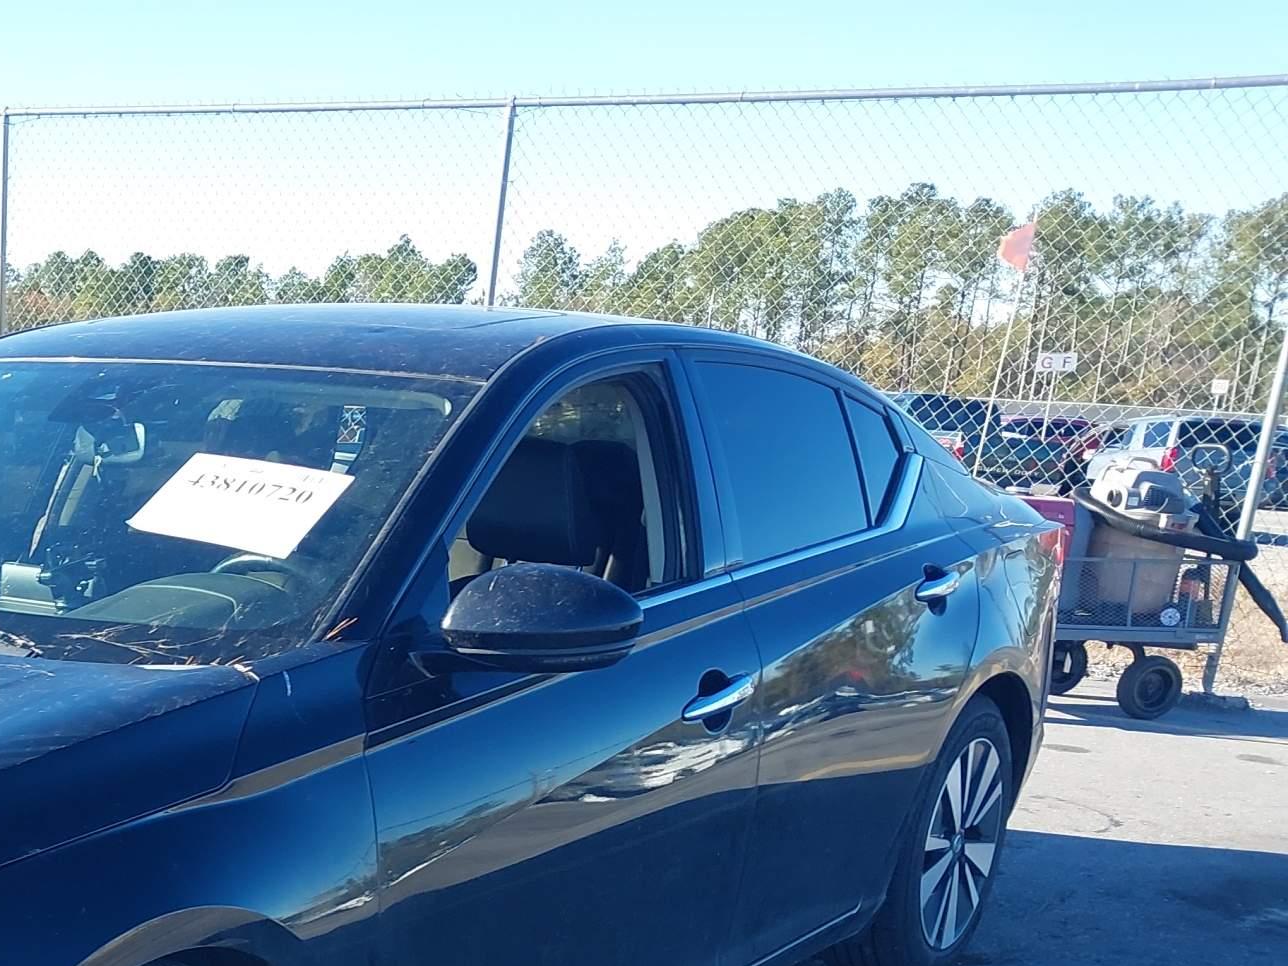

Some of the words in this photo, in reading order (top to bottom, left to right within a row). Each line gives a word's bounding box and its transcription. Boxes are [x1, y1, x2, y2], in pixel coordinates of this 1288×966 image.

[1041, 356, 1053, 368] G
[1062, 356, 1072, 368] F
[187, 473, 314, 504] 43810720
